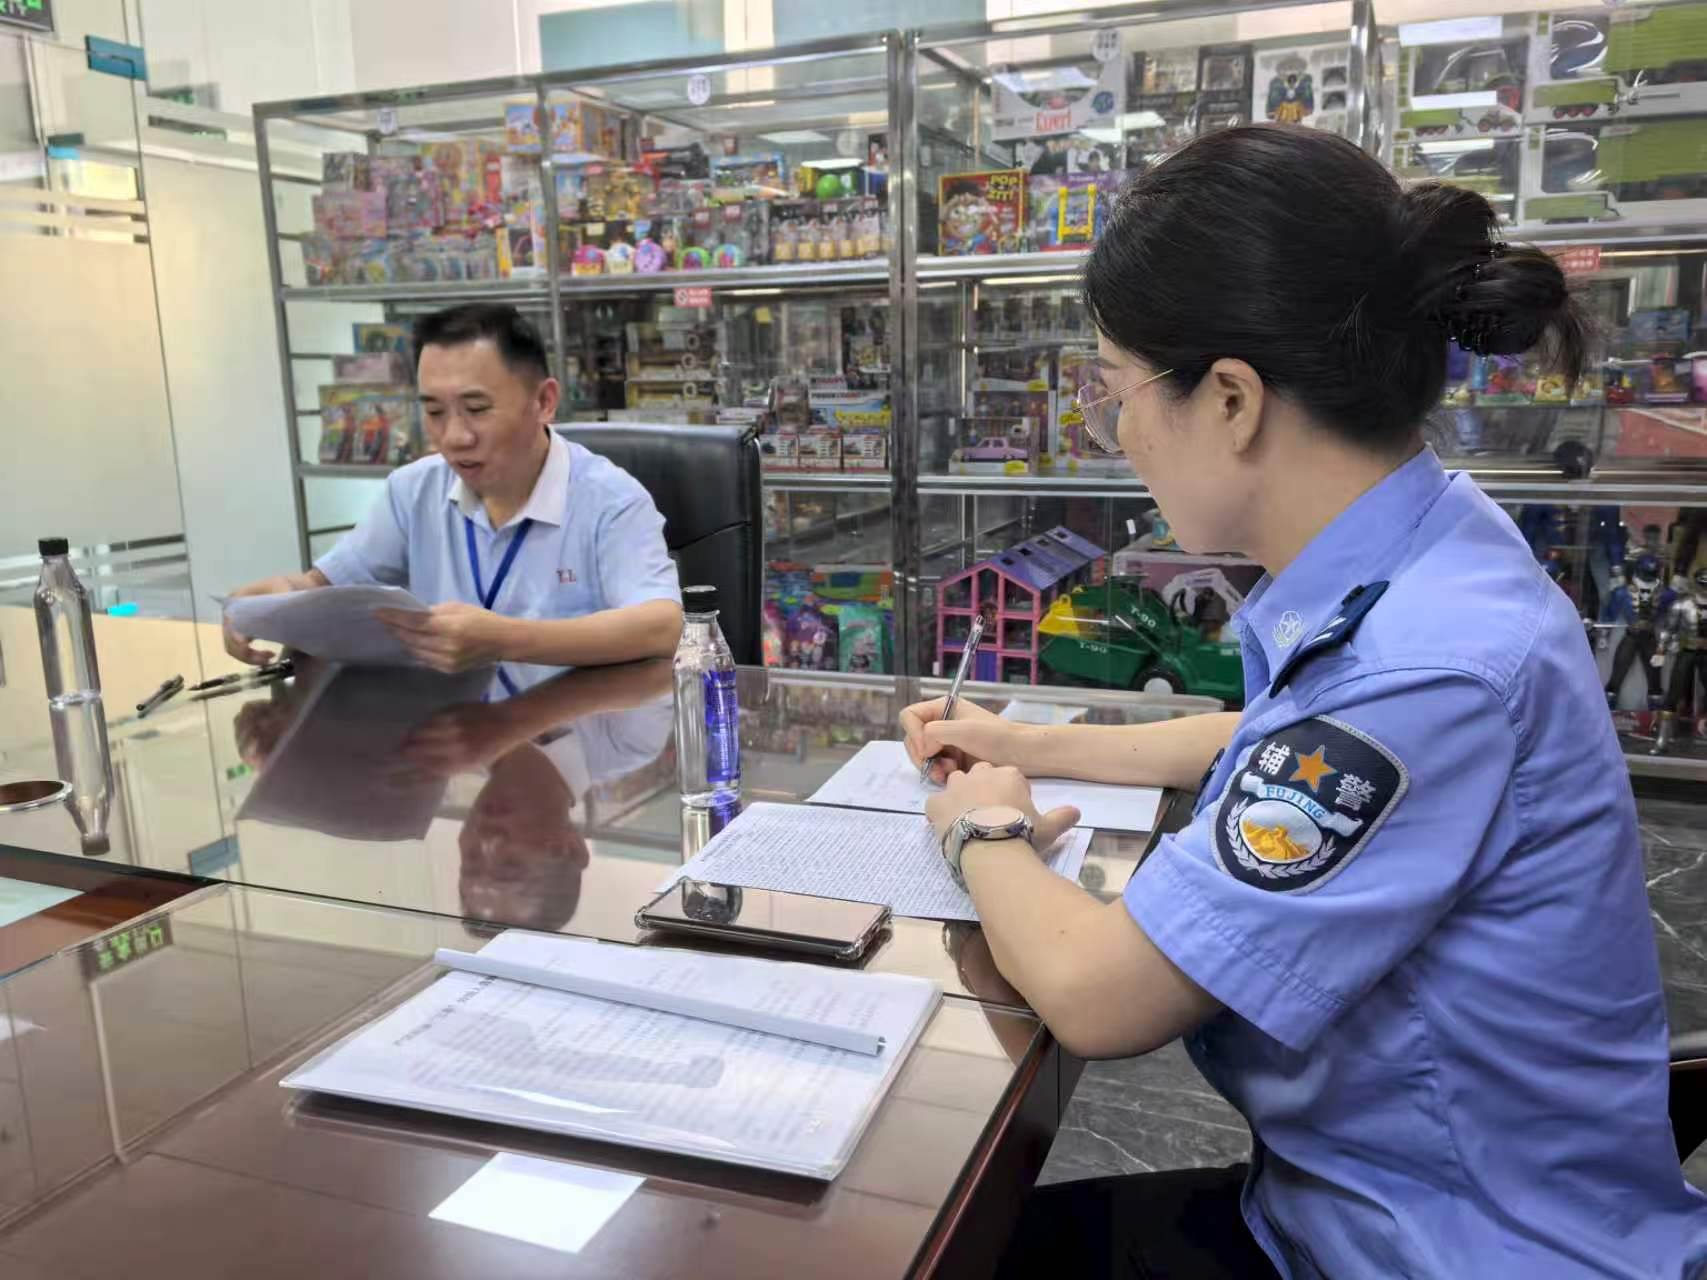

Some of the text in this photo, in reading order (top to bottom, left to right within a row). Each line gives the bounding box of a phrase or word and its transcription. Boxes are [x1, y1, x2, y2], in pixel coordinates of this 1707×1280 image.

[1129, 604, 1158, 629] T-90
[1263, 785, 1326, 820] FUJING
[1335, 773, 1377, 811] 警
